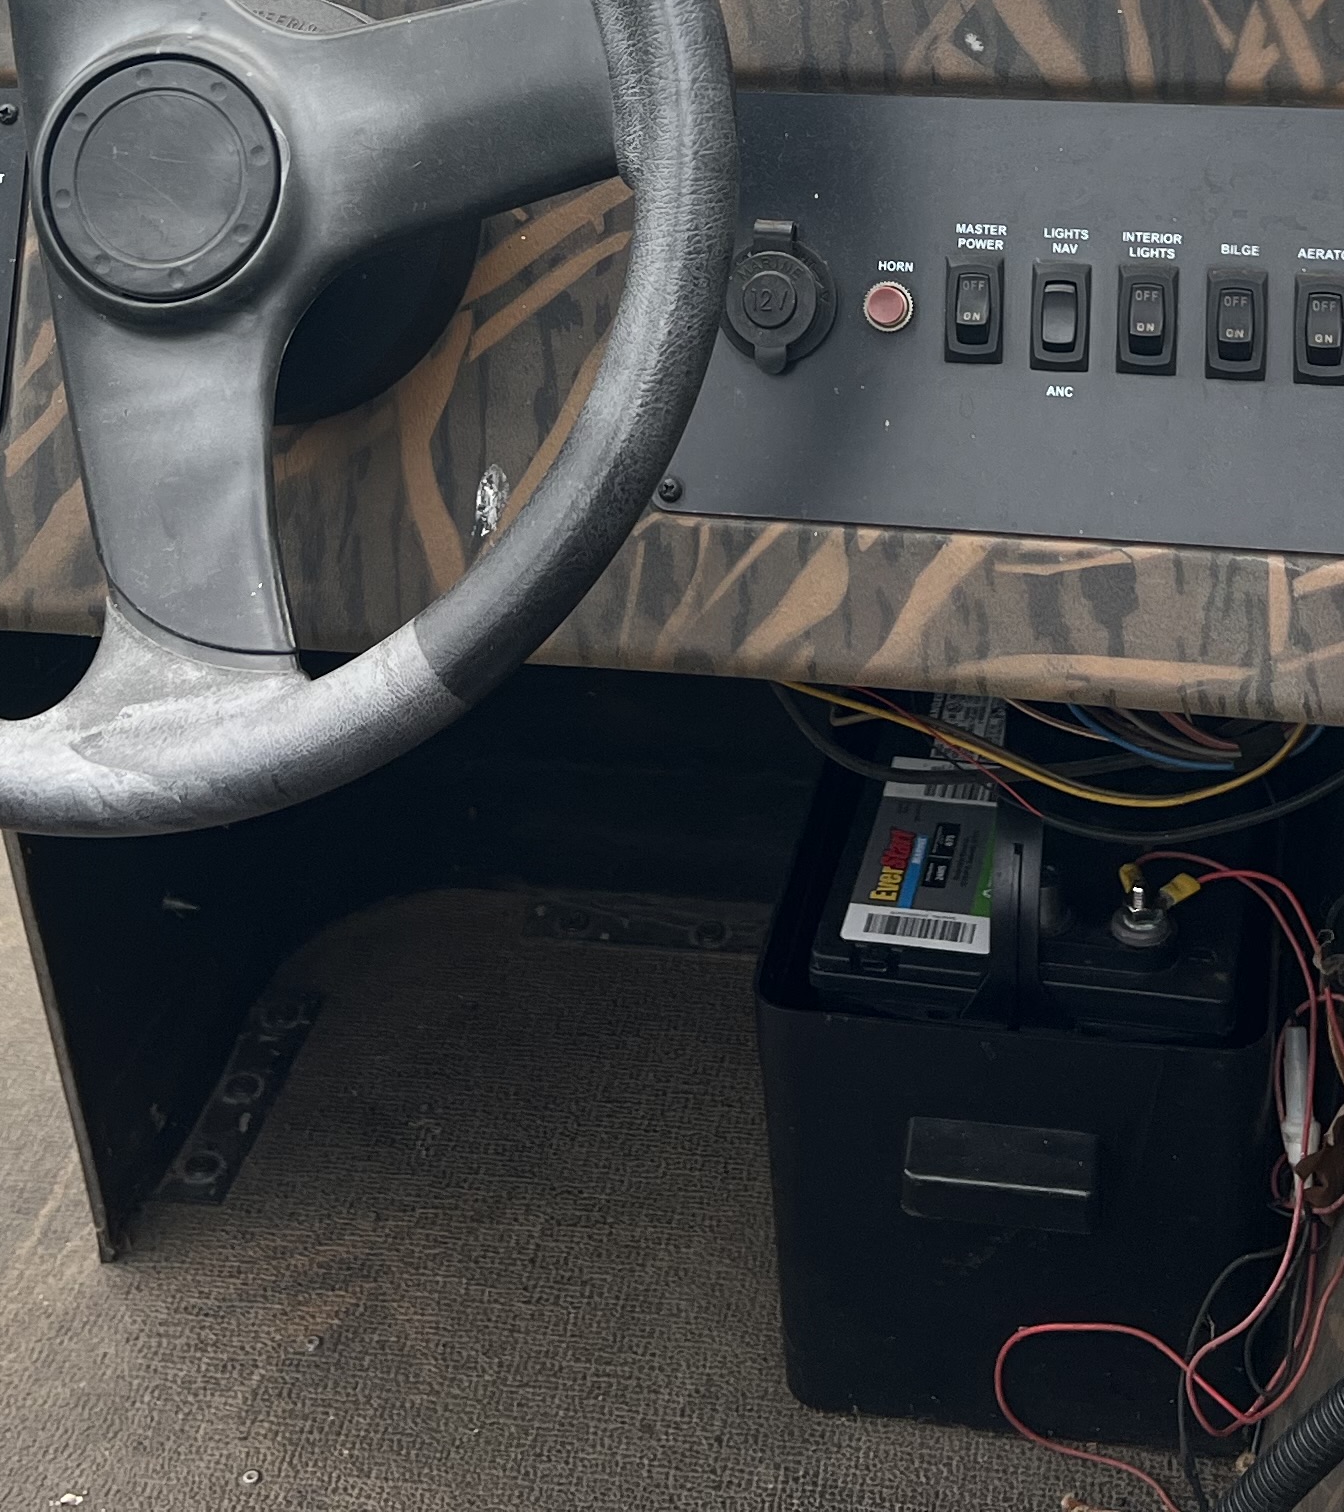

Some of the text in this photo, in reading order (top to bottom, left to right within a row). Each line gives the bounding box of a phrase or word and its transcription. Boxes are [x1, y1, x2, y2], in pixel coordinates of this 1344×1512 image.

[956, 223, 1007, 236] MASTER
[1043, 227, 1089, 241] LIGHTS
[957, 237, 1004, 251] POWER
[1122, 231, 1182, 245] INTERIOR
[1052, 243, 1078, 254] NAV
[1129, 247, 1176, 260] LIGHTS
[1220, 244, 1260, 257] BILGE
[736, 257, 805, 282] MARINE
[878, 260, 914, 273] HORN
[962, 280, 985, 291] OFF
[1135, 290, 1159, 302] OFF
[1223, 295, 1248, 307] OFF
[1312, 300, 1336, 312] OFF
[963, 311, 981, 321] ON
[1136, 322, 1155, 332] ON
[1225, 328, 1245, 338] ON
[1314, 334, 1333, 344] ON
[1046, 386, 1074, 398] ANC
[869, 828, 915, 901] EverStart
